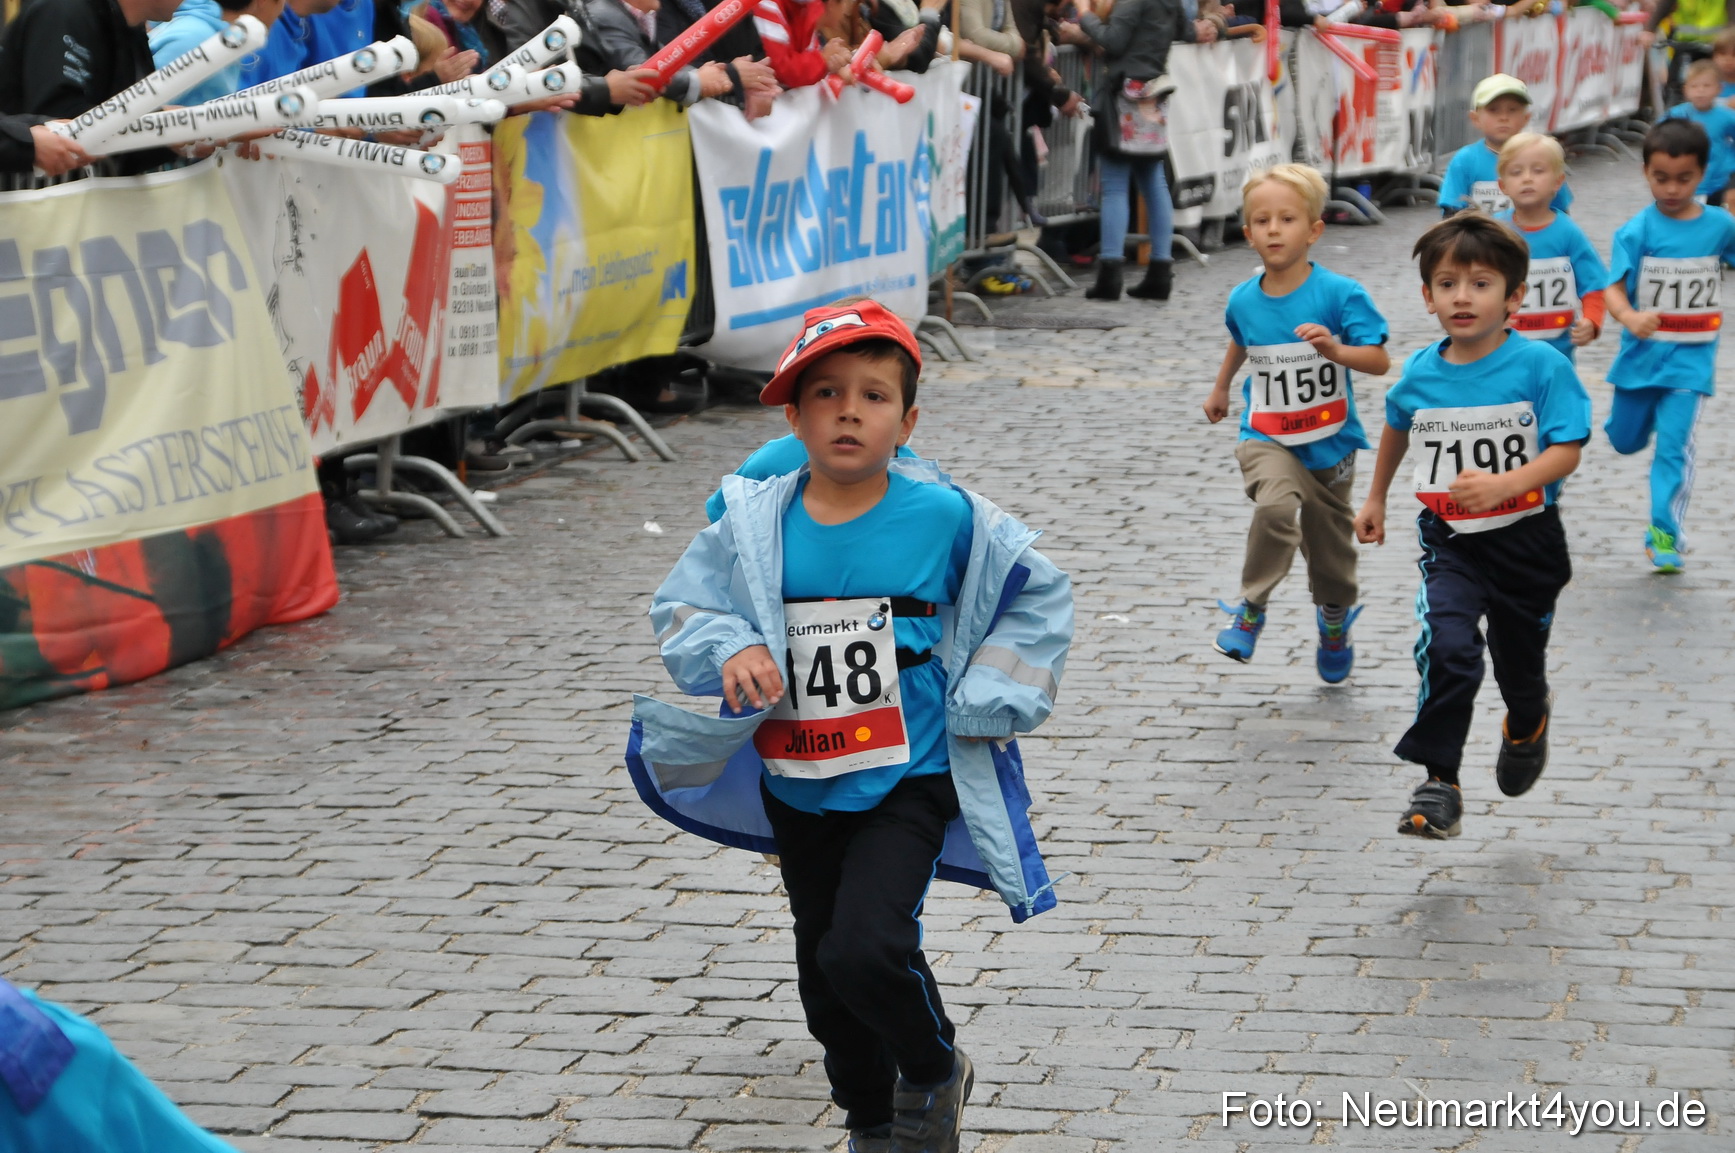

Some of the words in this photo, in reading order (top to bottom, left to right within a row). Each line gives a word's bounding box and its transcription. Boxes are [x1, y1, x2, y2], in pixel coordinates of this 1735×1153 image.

[656, 46, 685, 71] Audi
[684, 28, 708, 49] BKK
[348, 142, 408, 166] BMW
[1528, 266, 1560, 276] umarkt
[1643, 265, 1672, 275] PARTL
[1649, 277, 1718, 309] 7122
[1250, 355, 1275, 365] PARTL
[1276, 351, 1323, 364] Neumark
[1258, 362, 1338, 406] 7159
[1281, 413, 1317, 431] Quirin
[1412, 421, 1448, 434] PARTL
[1451, 418, 1513, 432] Neumarkt
[1425, 434, 1529, 485] 7198
[0, 404, 308, 543] FLASTERSTEINE
[785, 619, 859, 637] eumarkt
[884, 693, 892, 704] K
[785, 729, 846, 754] Julian
